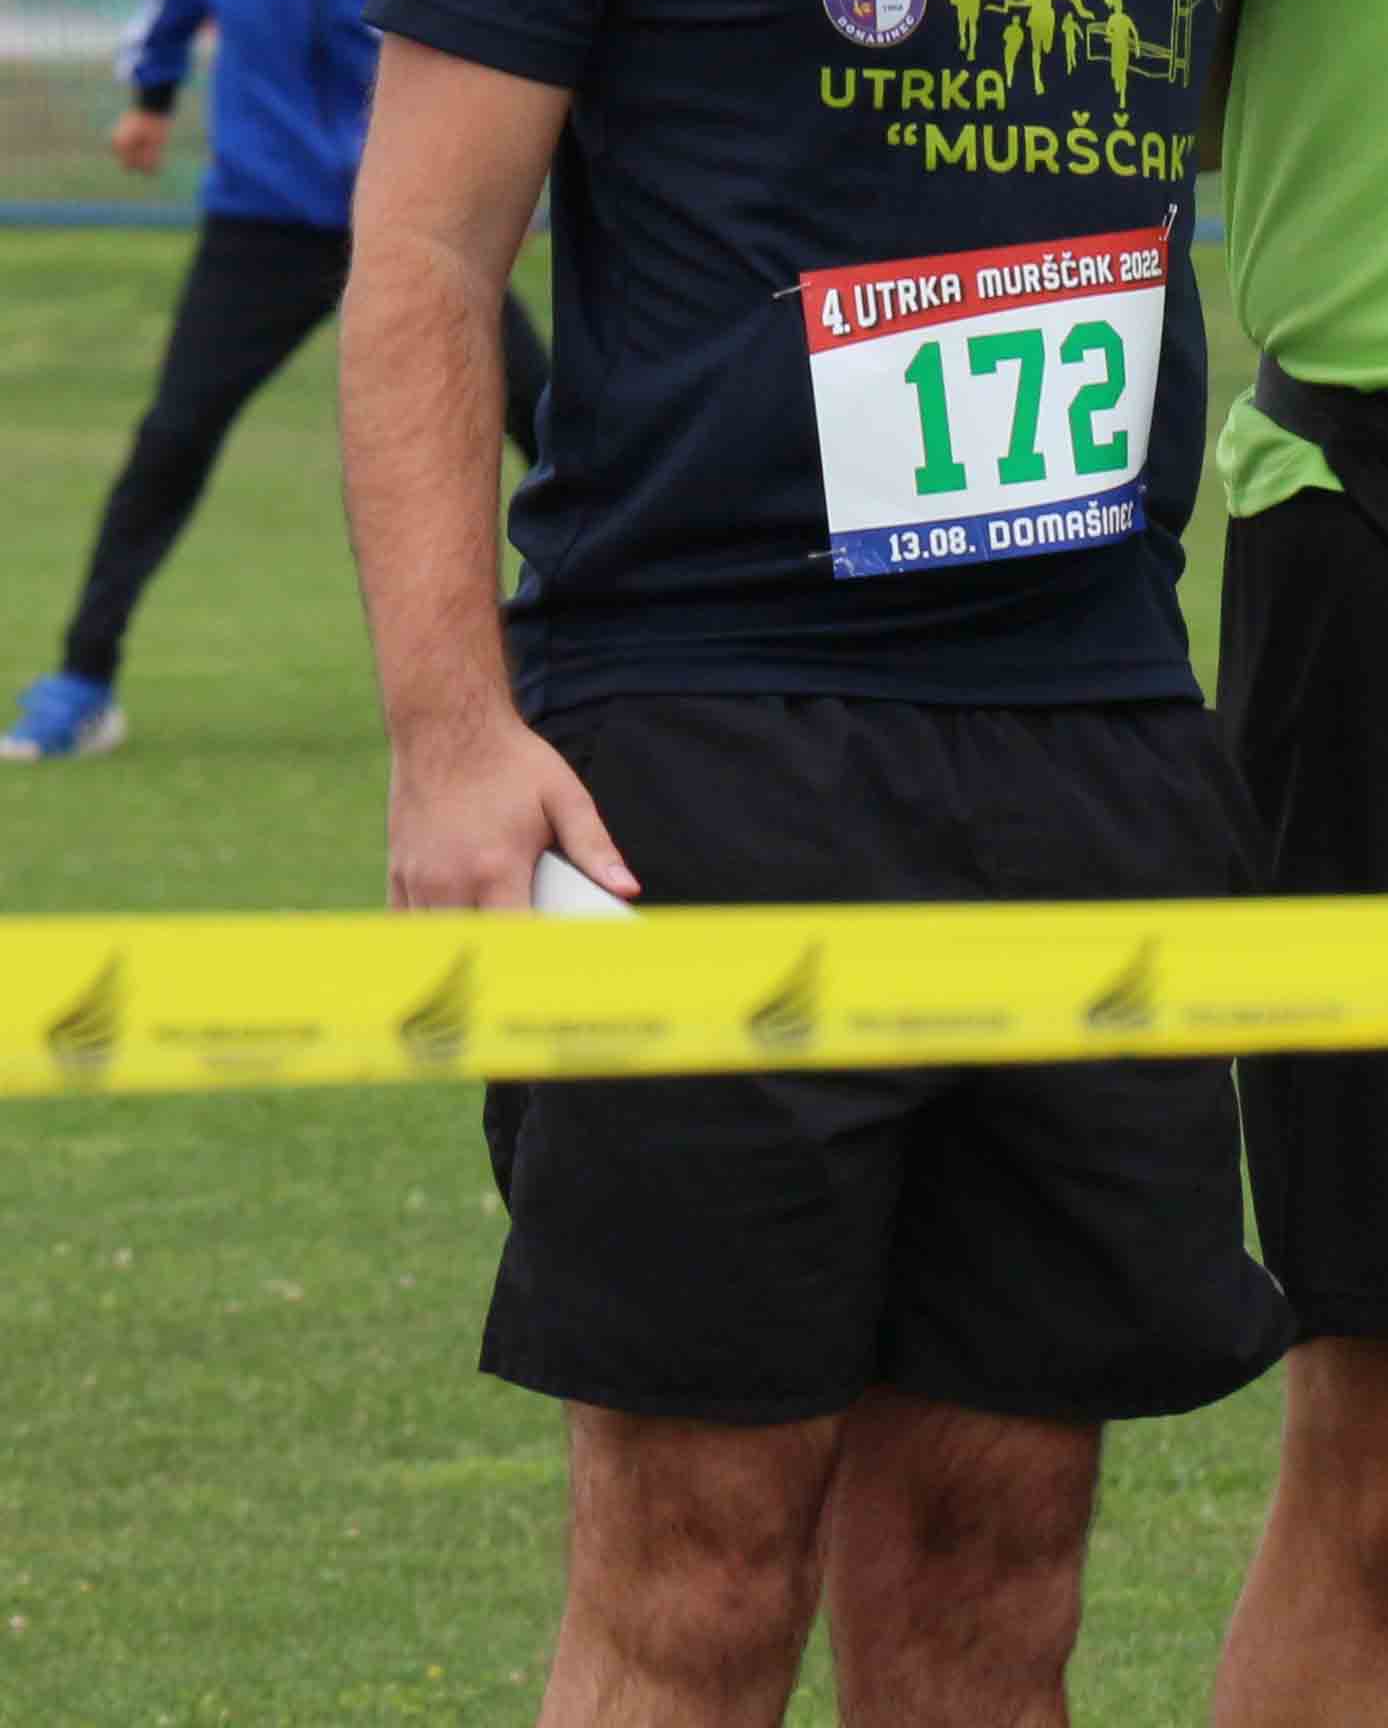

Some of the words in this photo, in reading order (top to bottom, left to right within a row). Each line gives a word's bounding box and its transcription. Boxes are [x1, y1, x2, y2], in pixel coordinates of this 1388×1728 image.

[820, 67, 1006, 111] UTRKA
[821, 288, 850, 336] 4.
[854, 273, 962, 328] UTRKA
[976, 251, 1113, 300] MURŠČAK
[1119, 248, 1163, 281] 2022.
[903, 320, 1128, 496] 172
[889, 526, 976, 562] 13.08.
